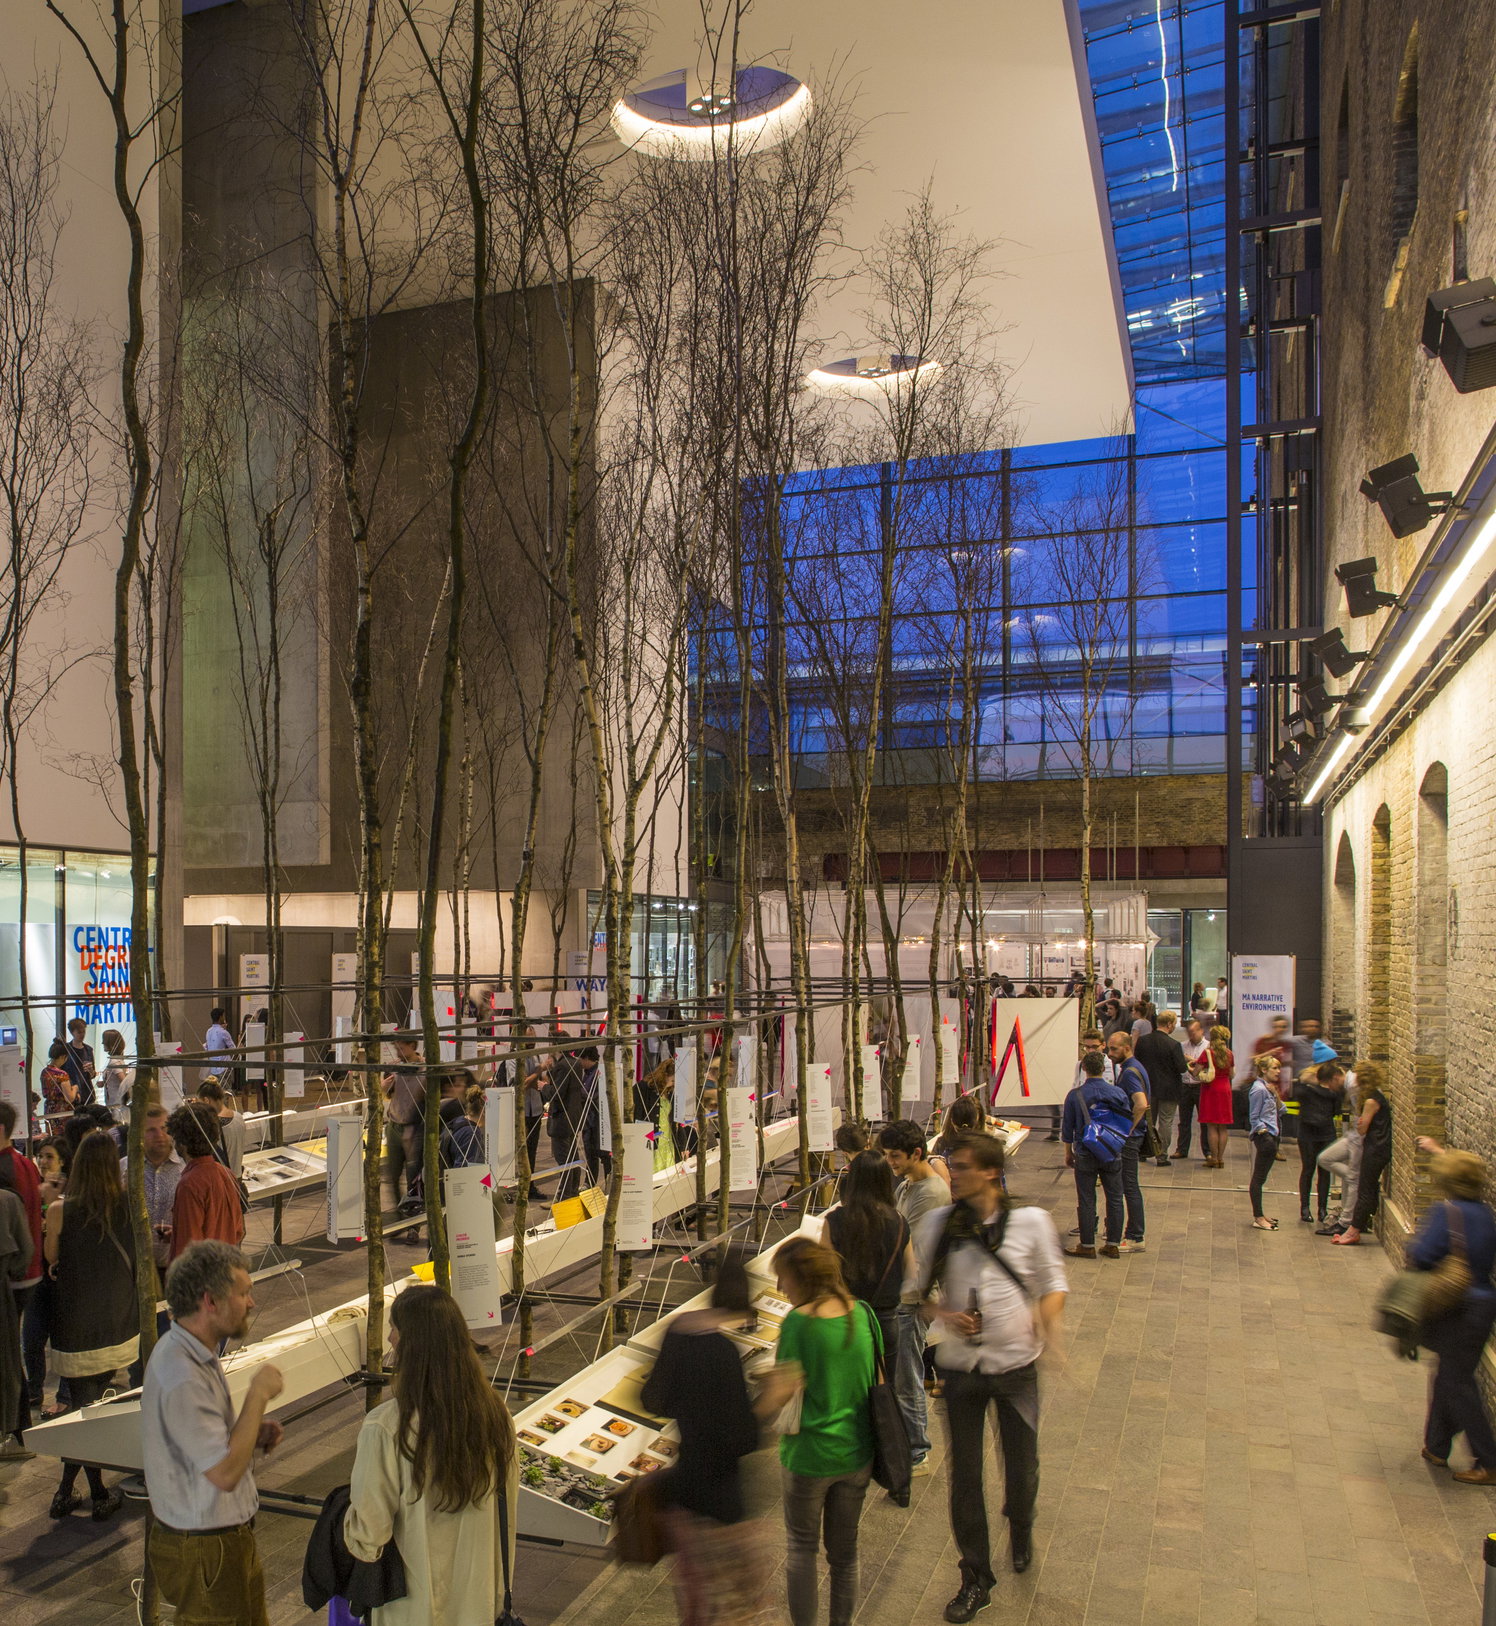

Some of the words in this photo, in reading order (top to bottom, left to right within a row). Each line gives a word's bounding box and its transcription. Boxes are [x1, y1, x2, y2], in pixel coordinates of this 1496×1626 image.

[88, 962, 130, 989] SAIN
[1242, 993, 1250, 1001] MA
[1252, 993, 1284, 1002] NARRATIVE
[1242, 1003, 1286, 1011] ENVIRONMENTS
